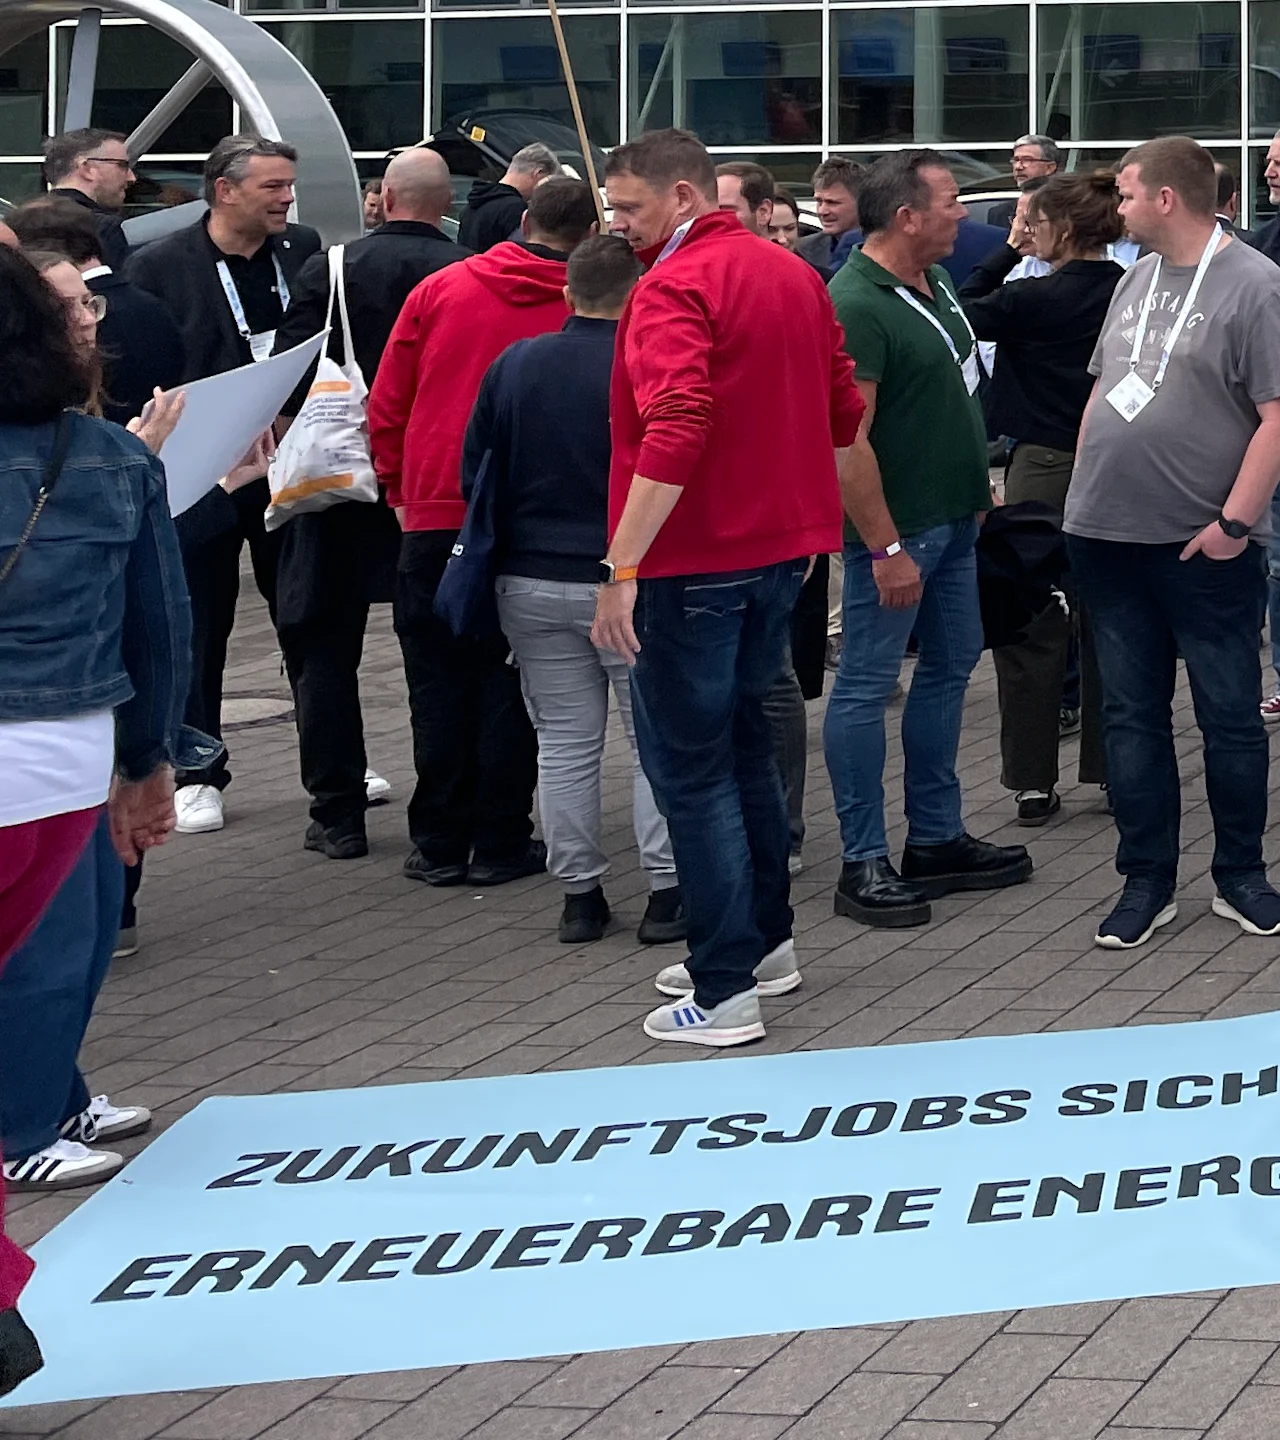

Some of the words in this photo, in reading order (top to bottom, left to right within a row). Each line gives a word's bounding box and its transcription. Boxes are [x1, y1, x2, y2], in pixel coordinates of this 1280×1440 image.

[1120, 291, 1205, 330] MSTAG
[206, 1088, 1031, 1191] ZUKUNFTSJOBS
[92, 1187, 942, 1304] ERNEUERBARE
